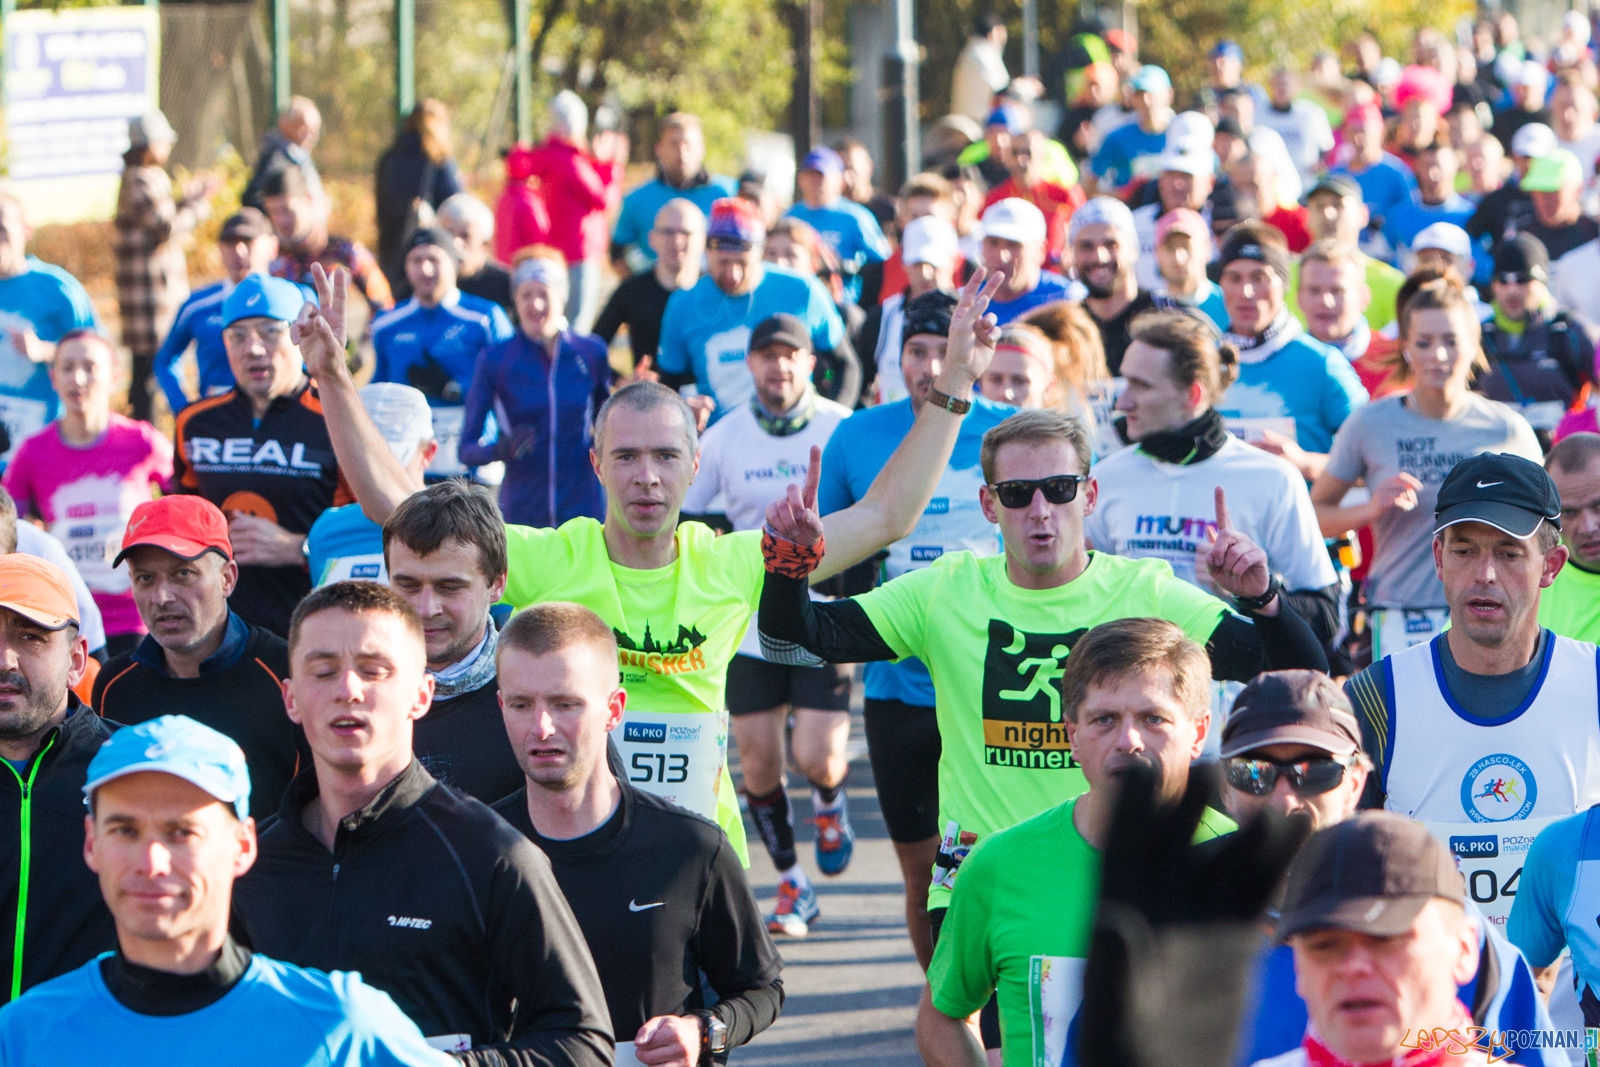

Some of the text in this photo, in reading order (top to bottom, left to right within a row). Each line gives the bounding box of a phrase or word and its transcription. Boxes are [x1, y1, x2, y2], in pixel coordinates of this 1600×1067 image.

[1397, 437, 1436, 452] NOT
[190, 436, 322, 471] REAL
[628, 727, 663, 738] 16. PKO
[1004, 722, 1070, 749] night
[630, 752, 690, 784] 513
[1453, 841, 1495, 853] 16. PKO
[396, 916, 433, 930] HI-TEC
